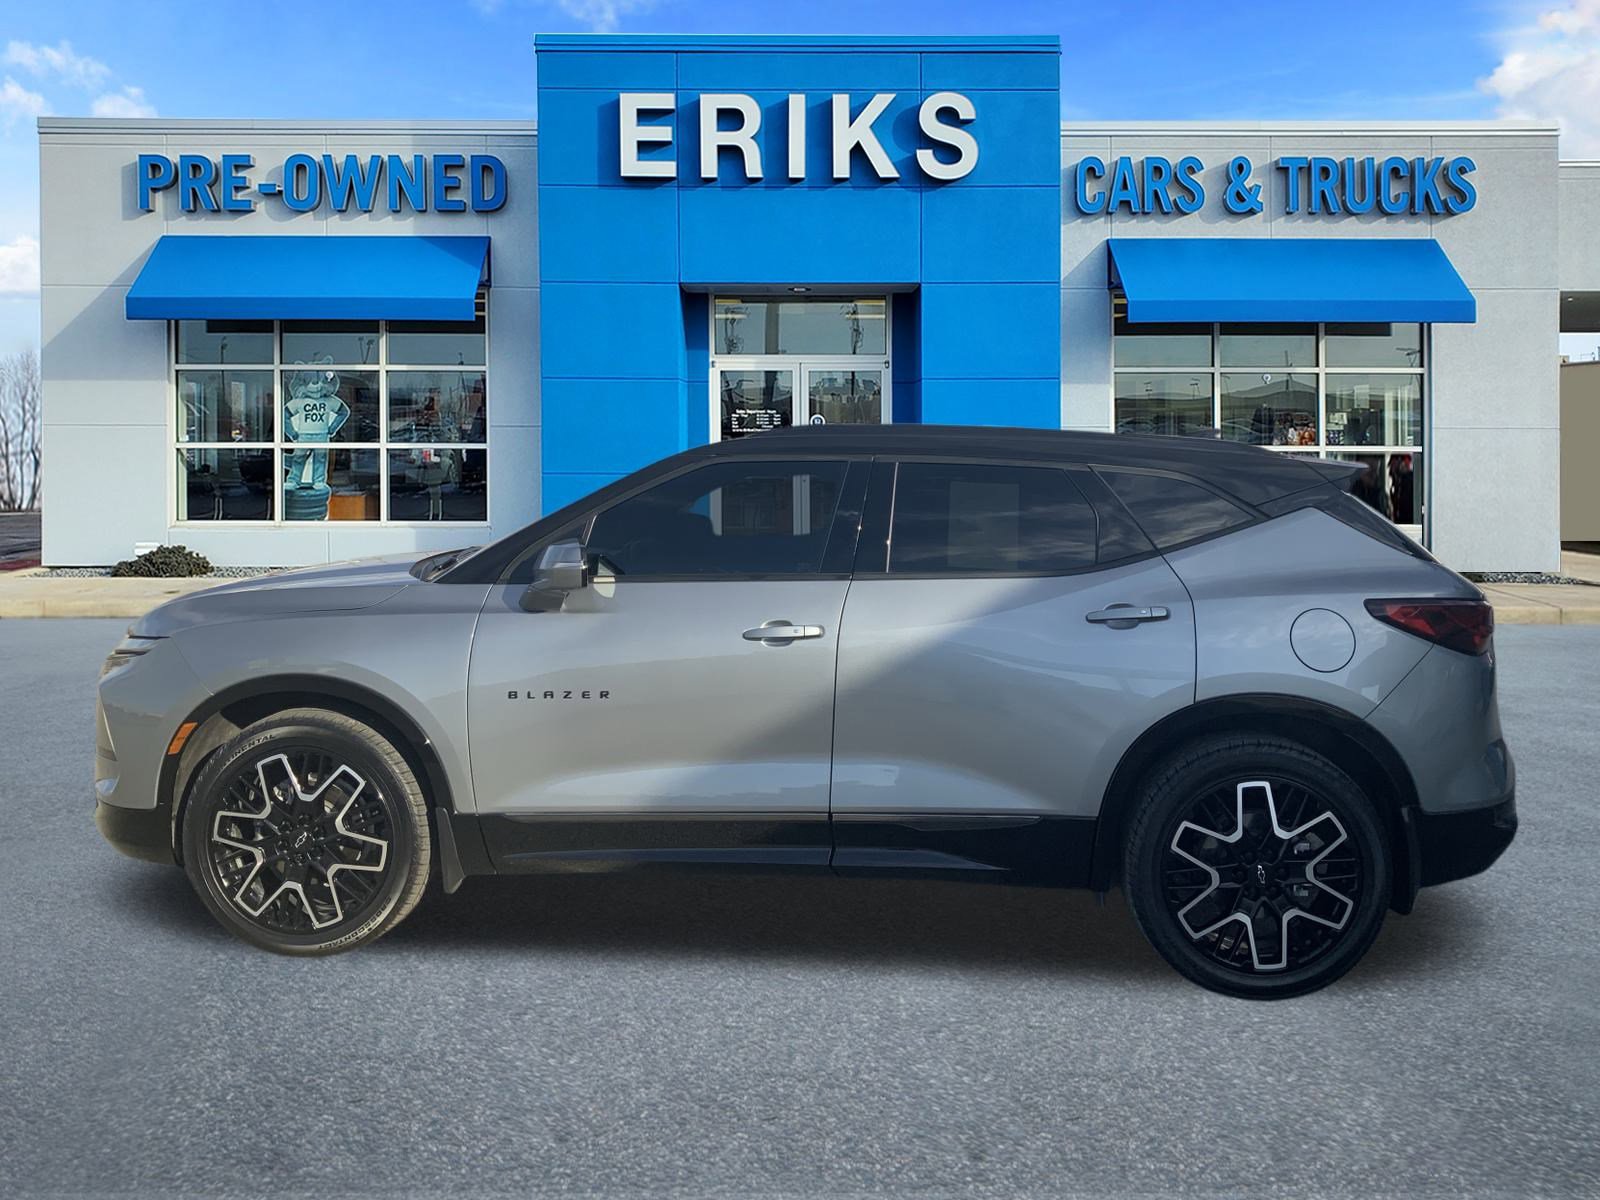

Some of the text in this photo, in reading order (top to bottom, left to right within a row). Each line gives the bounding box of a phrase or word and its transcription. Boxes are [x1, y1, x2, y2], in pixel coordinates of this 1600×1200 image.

[619, 92, 979, 180] ERIKS
[138, 154, 508, 212] PRE-OWNED
[1075, 156, 1478, 216] CARS & TRUCKS
[303, 403, 326, 412] CAR
[304, 413, 324, 423] FOX
[507, 690, 610, 699] BLAZER
